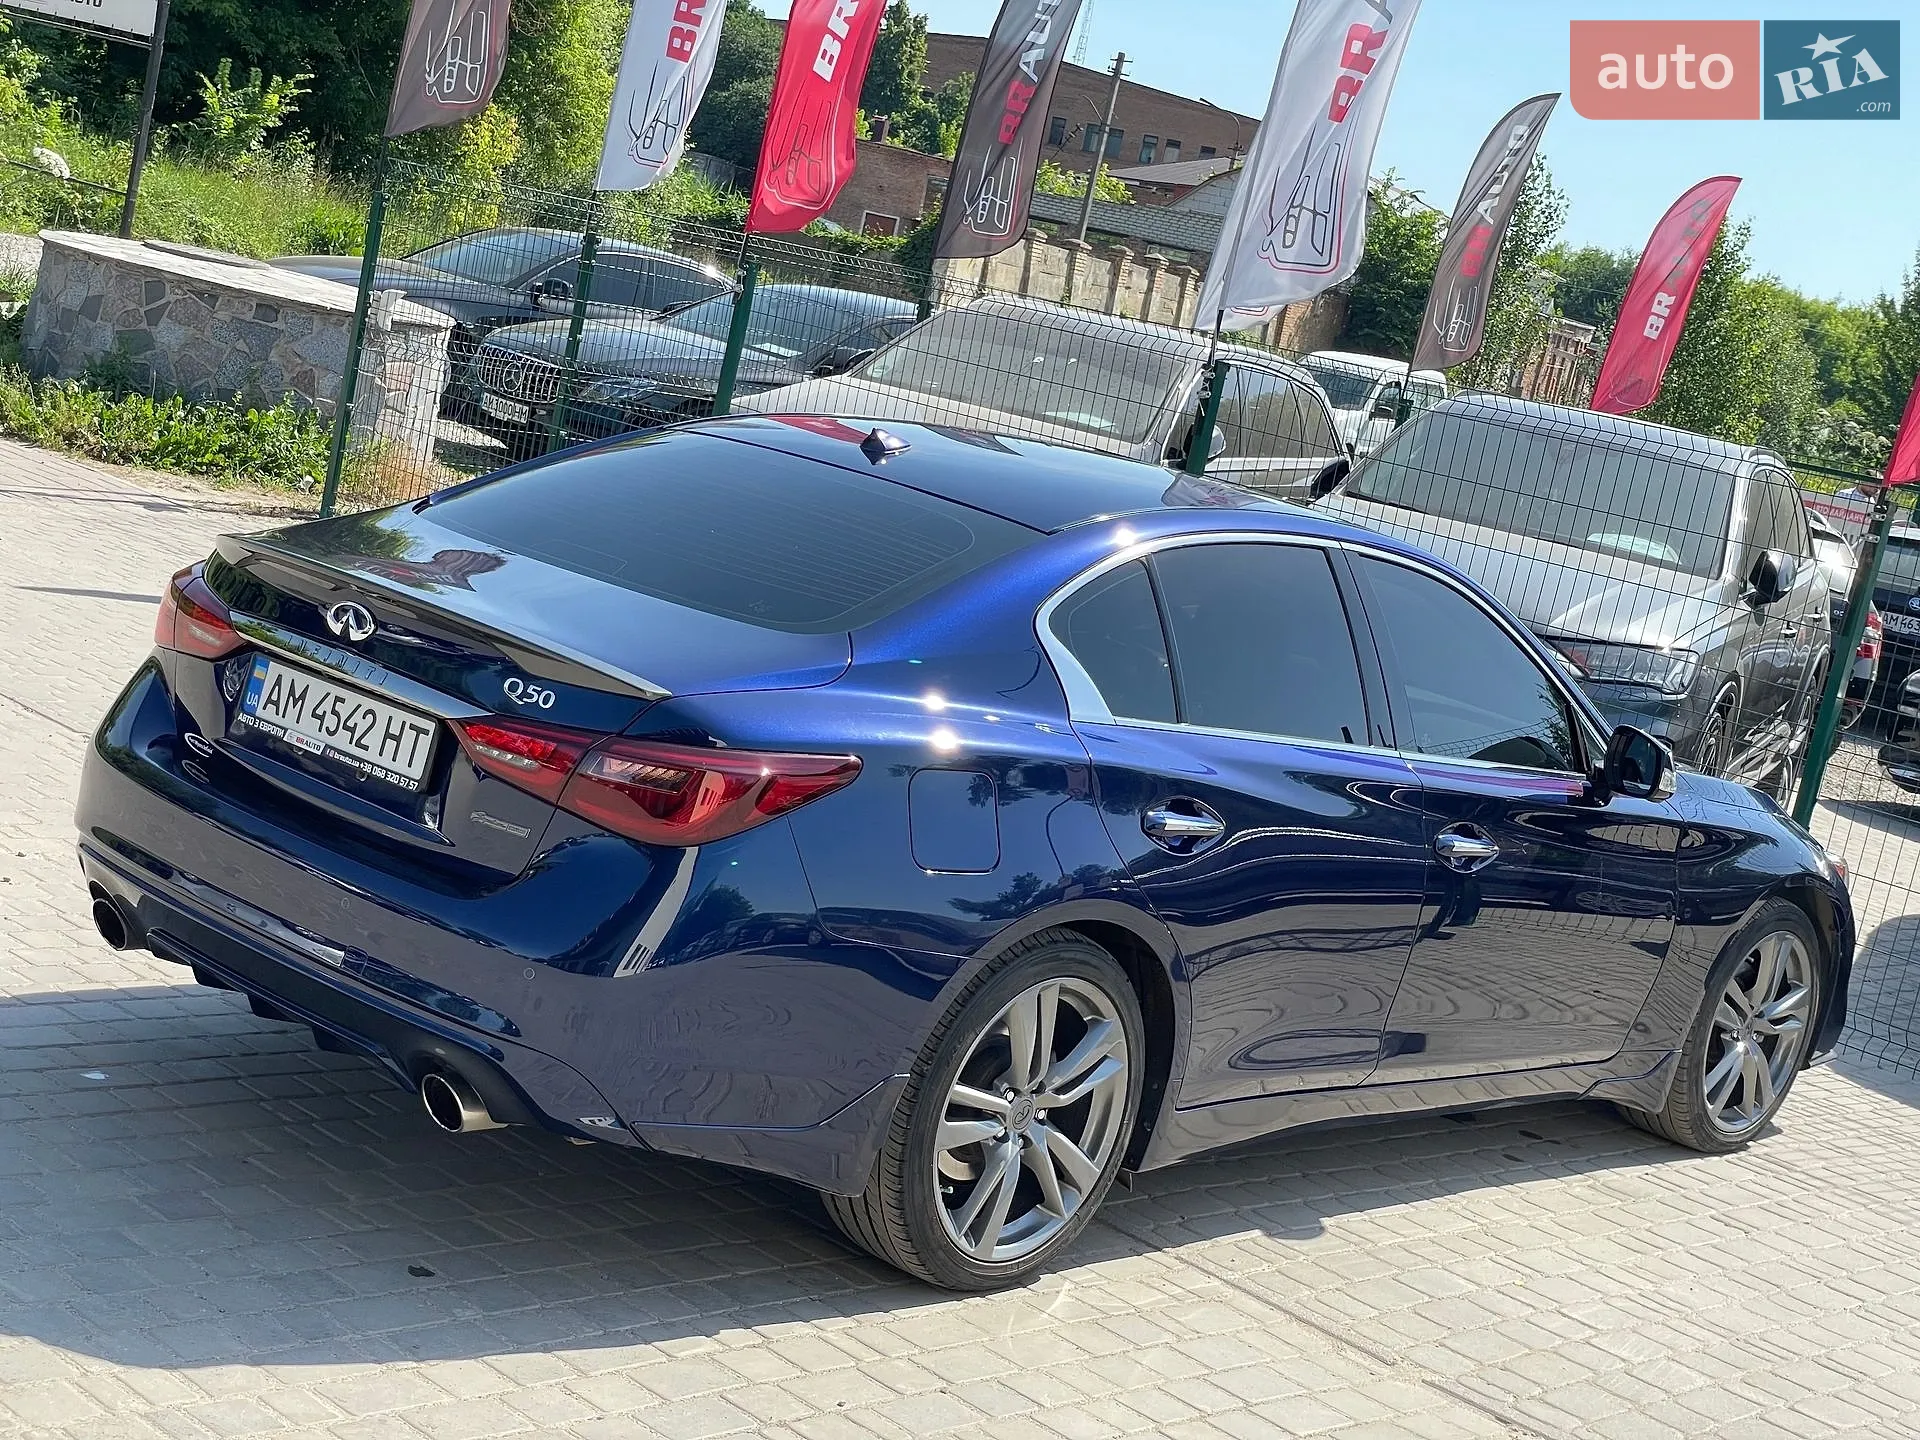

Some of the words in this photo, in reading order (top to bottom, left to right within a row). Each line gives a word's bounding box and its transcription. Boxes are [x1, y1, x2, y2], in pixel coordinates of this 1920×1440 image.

[283, 634, 390, 686] INFINITI
[246, 691, 258, 708] UA
[503, 677, 556, 709] Q50
[262, 673, 310, 724] AM
[311, 691, 378, 751] 4542
[379, 715, 430, 768] HT
